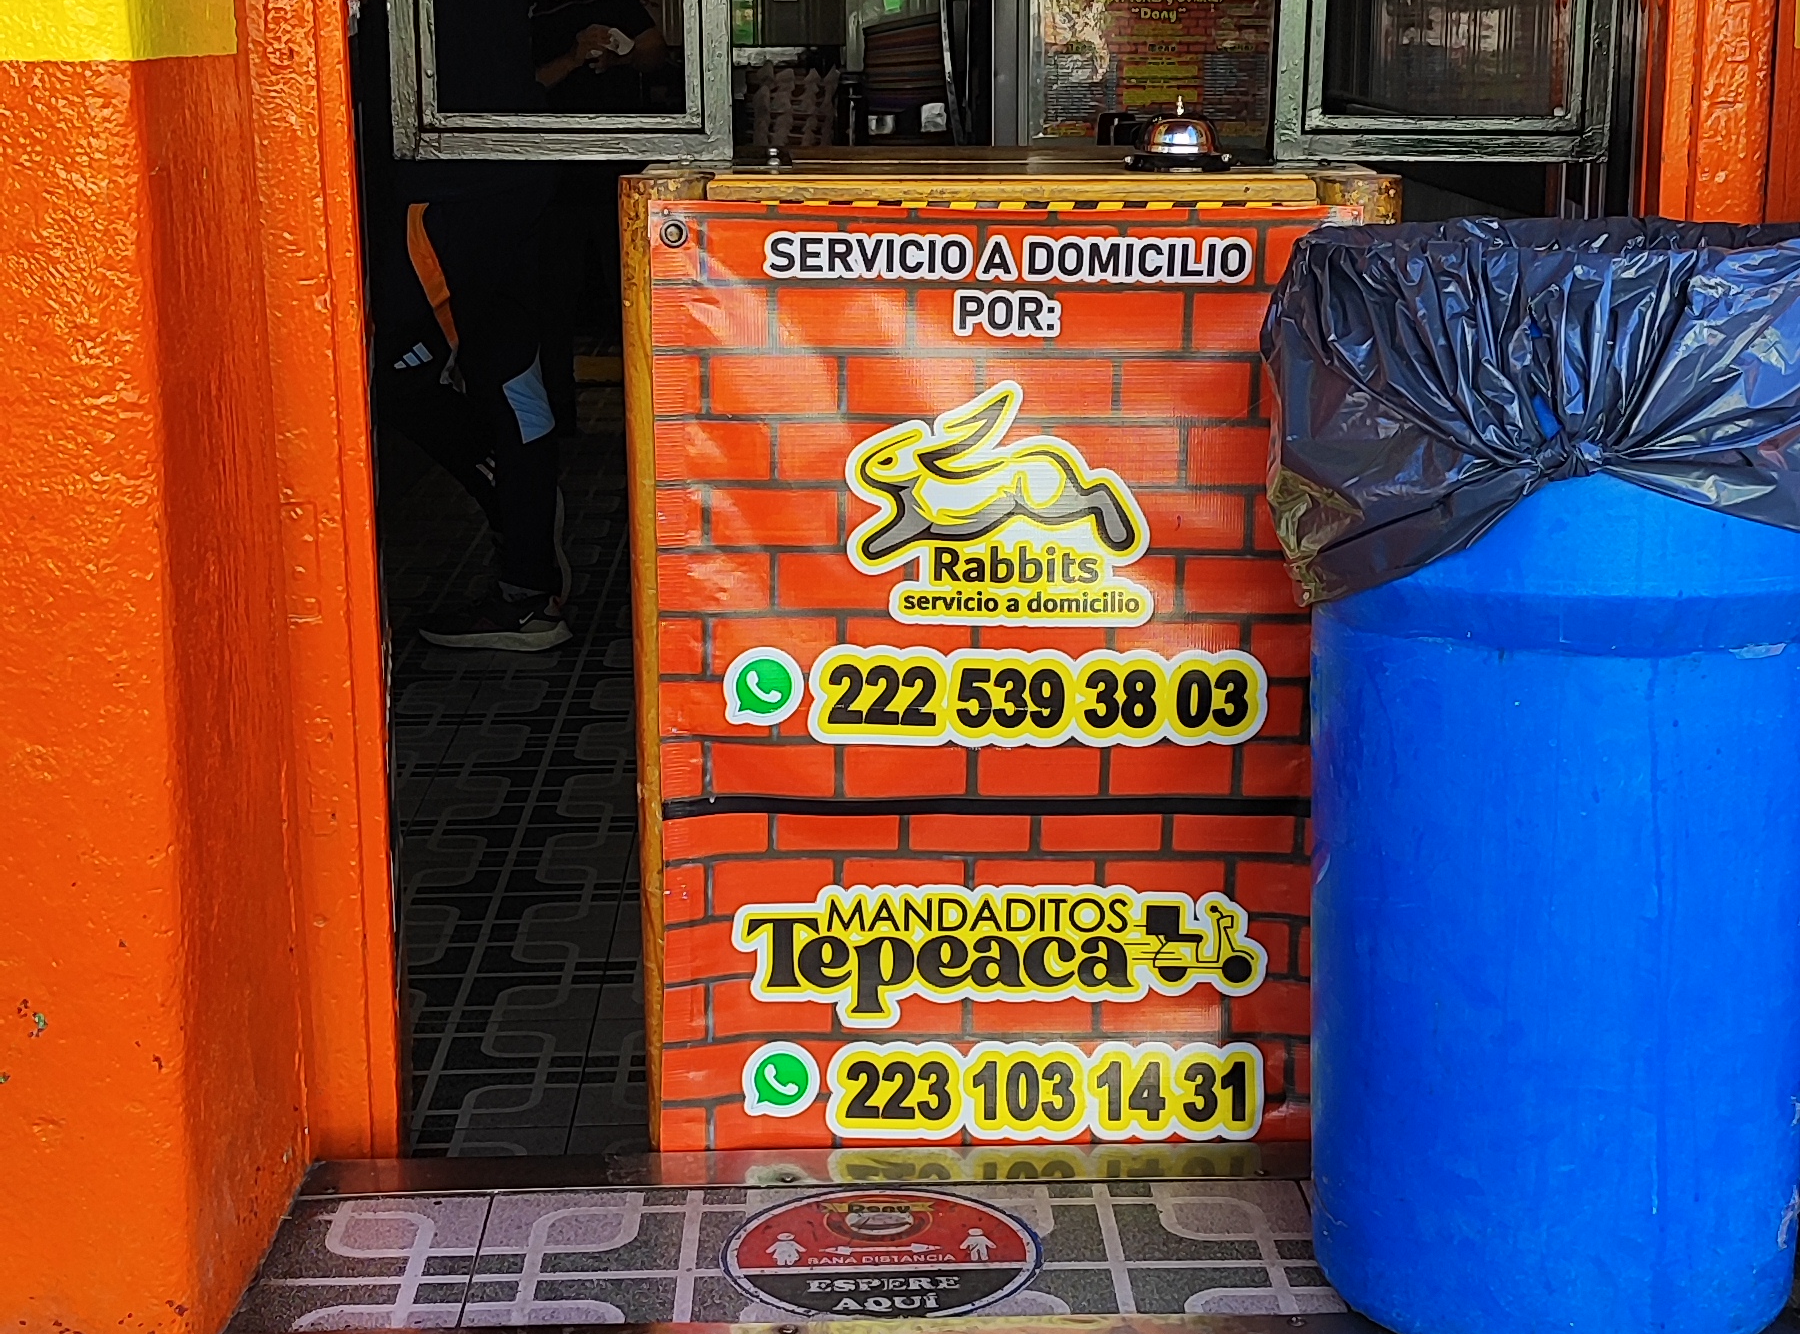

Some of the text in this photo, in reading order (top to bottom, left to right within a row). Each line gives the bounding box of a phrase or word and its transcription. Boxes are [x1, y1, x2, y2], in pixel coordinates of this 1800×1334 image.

[768, 236, 1248, 279] SERVICIO A DOMICILIO
[957, 296, 1060, 333] POR:
[932, 546, 1100, 585] Rabbits
[902, 591, 1140, 614] servicio a domicilio
[828, 664, 1250, 729] 222 539 38 03
[826, 896, 1130, 933] MANDADITOS
[747, 917, 1135, 1015] Tepeaca
[845, 1060, 1247, 1122] 223 103 14 31
[806, 1276, 961, 1293] ESPERE
[832, 1292, 940, 1312] AQUÍ
